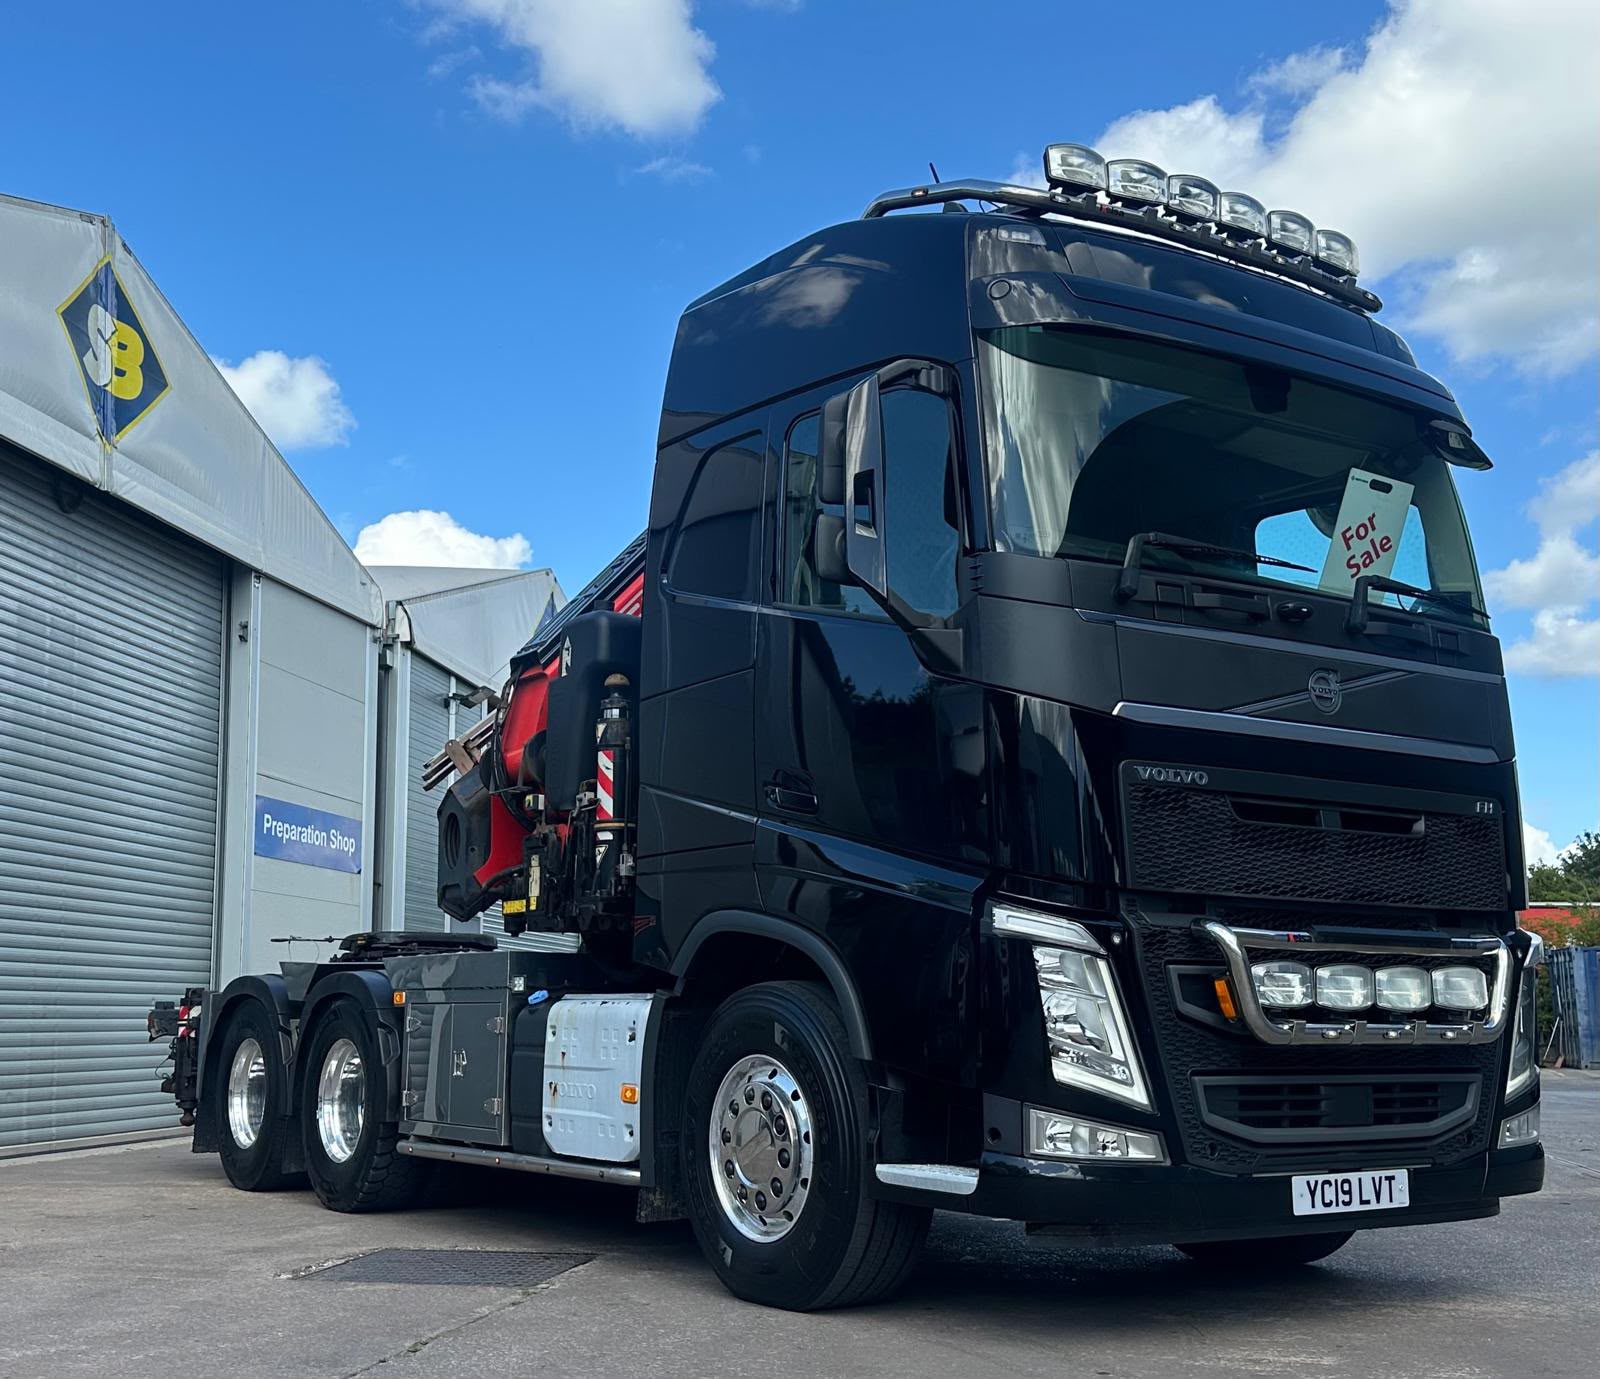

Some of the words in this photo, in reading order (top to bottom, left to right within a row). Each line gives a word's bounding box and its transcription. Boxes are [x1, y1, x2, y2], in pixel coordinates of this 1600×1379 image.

[83, 303, 145, 400] SB
[1341, 512, 1376, 551] For
[1346, 535, 1393, 579] Sale
[1133, 765, 1209, 785] VOLVO
[263, 813, 328, 844] Preparation
[329, 829, 356, 856] Shop
[1306, 1178, 1353, 1209] YC19
[1358, 1175, 1396, 1206] LVT
